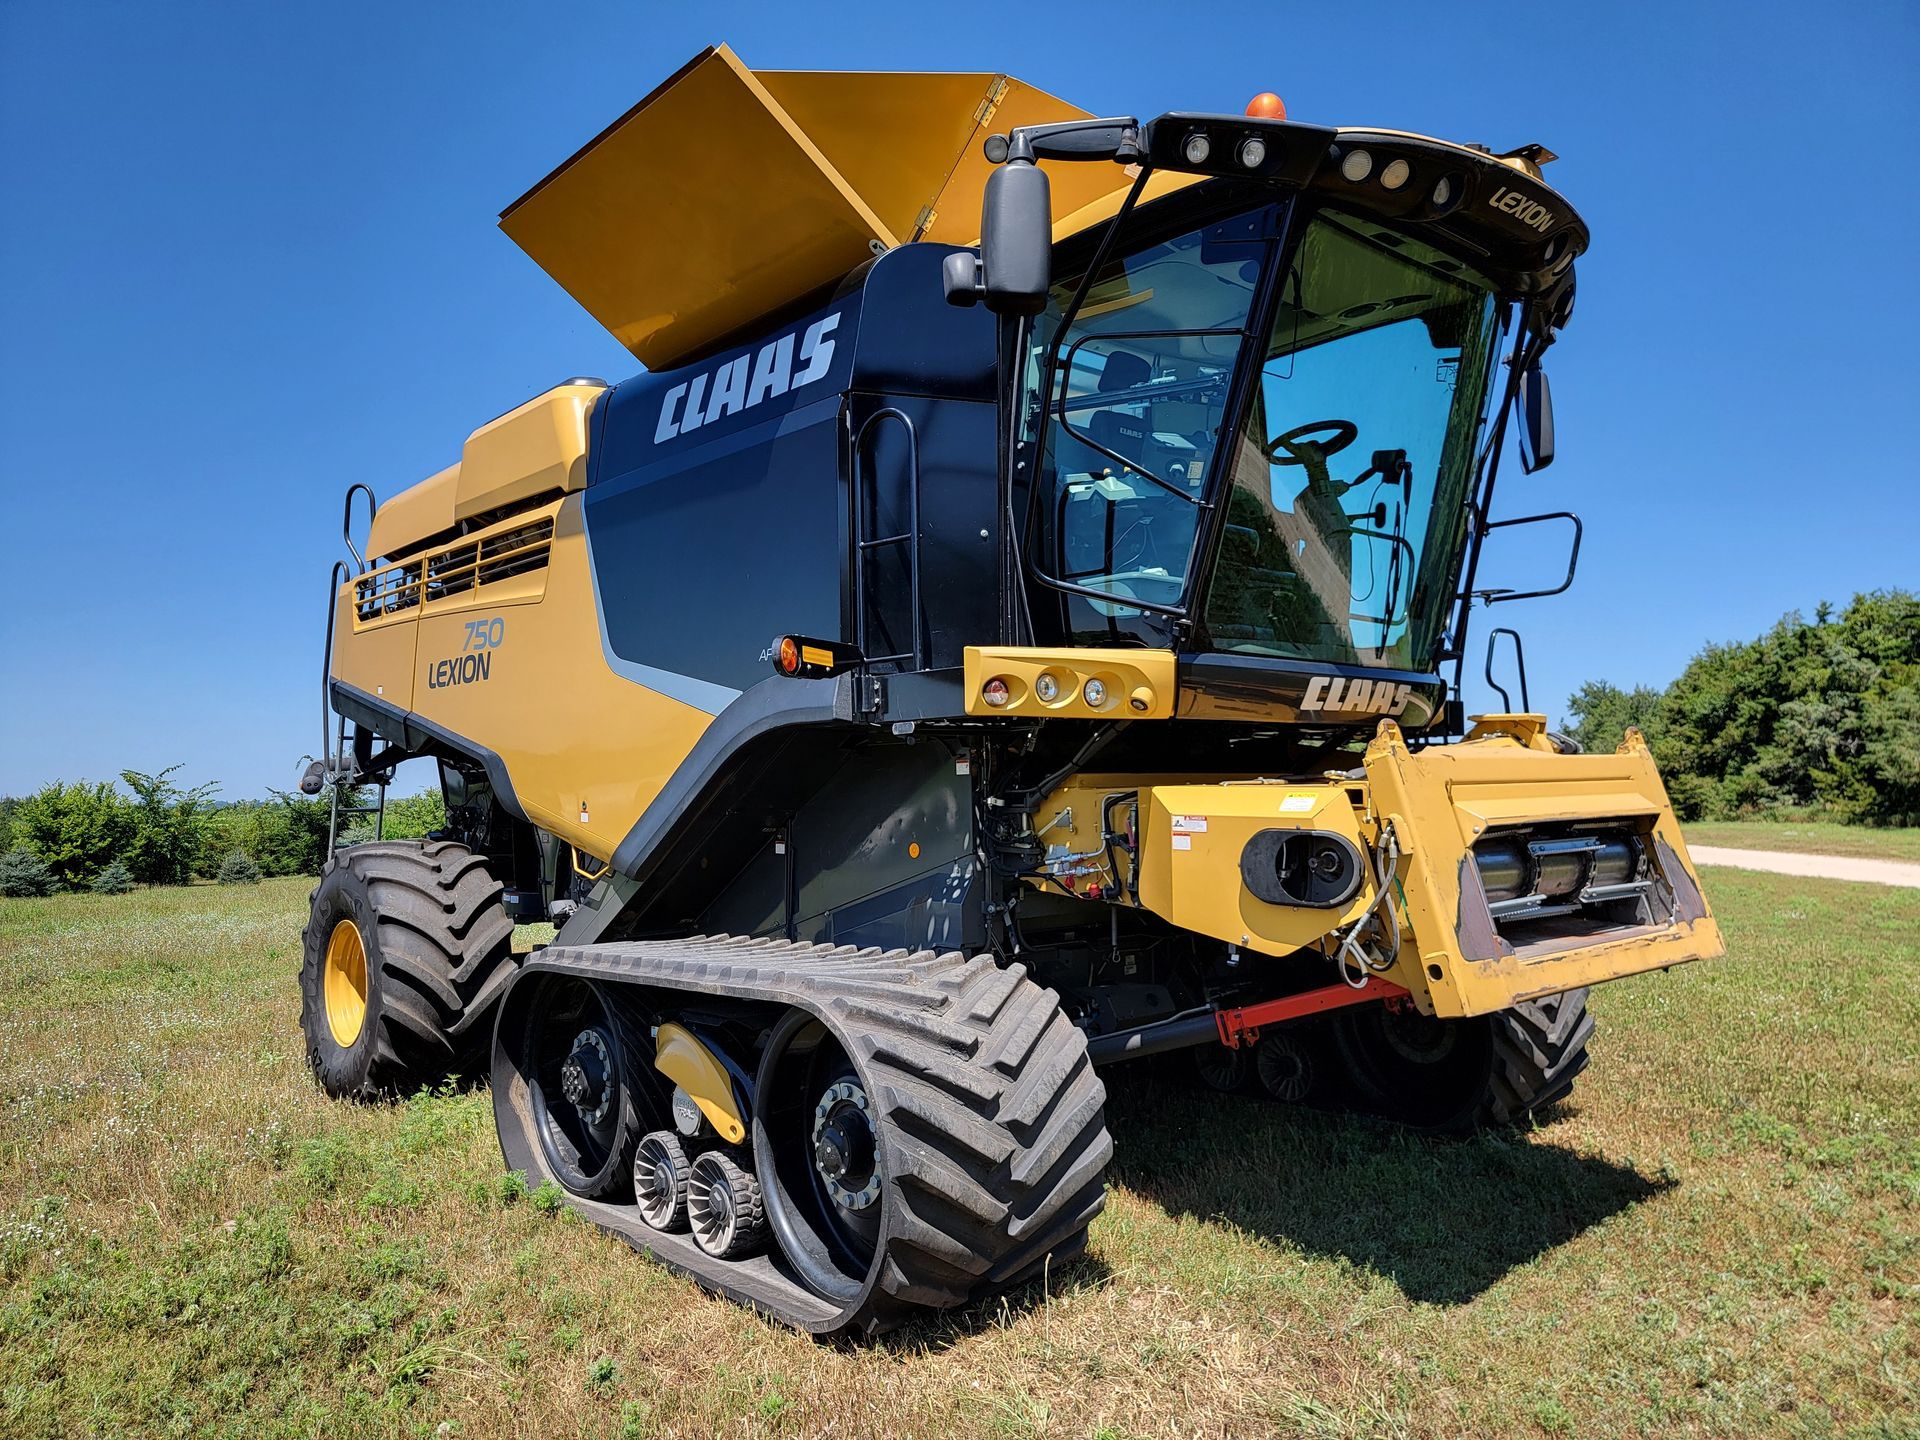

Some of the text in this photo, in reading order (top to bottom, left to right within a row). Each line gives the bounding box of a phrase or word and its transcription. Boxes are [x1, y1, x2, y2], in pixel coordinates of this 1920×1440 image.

[1488, 186, 1556, 233] LEXION
[653, 311, 842, 445] CLAAS
[463, 617, 505, 652] 750
[428, 651, 492, 689] LEXION
[1299, 676, 1412, 716] CLAAS
